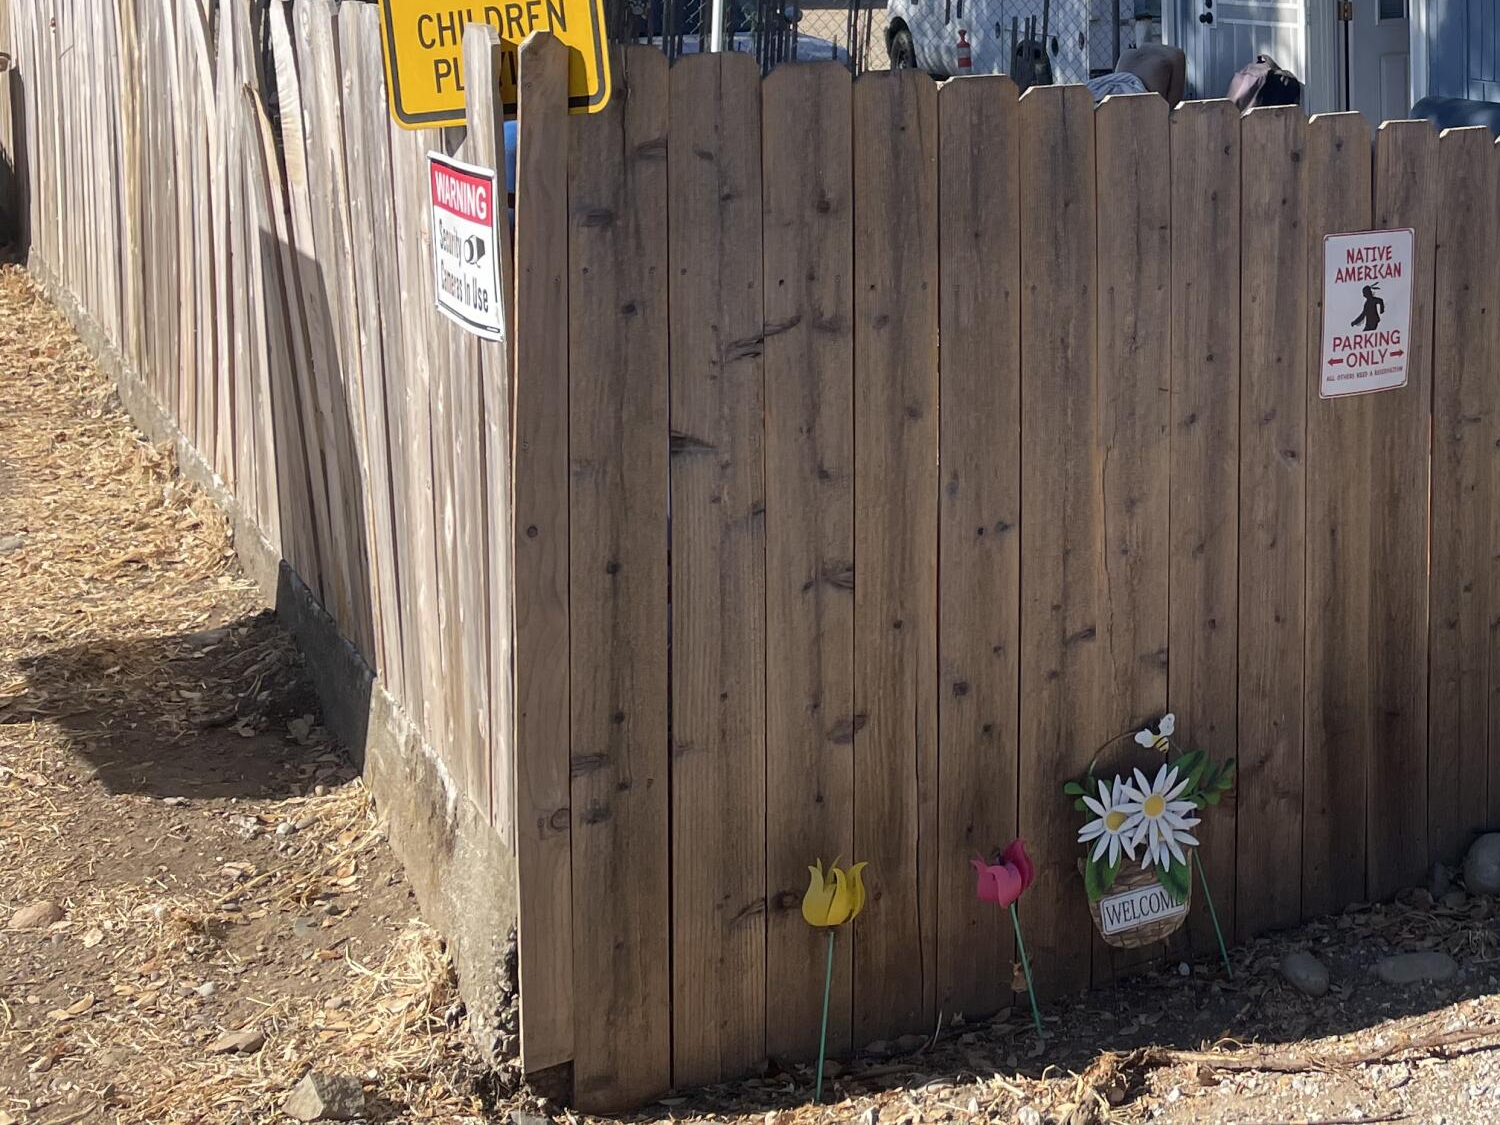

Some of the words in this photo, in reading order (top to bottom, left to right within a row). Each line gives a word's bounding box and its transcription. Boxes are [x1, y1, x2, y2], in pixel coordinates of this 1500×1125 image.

[434, 170, 487, 220] WARNING
[439, 218, 462, 268] Security
[1346, 245, 1393, 265] NATIVE
[1335, 262, 1402, 284] AMERICAN
[472, 277, 489, 314] Use
[1332, 329, 1401, 353] PARKING
[1346, 347, 1388, 368] ONLY
